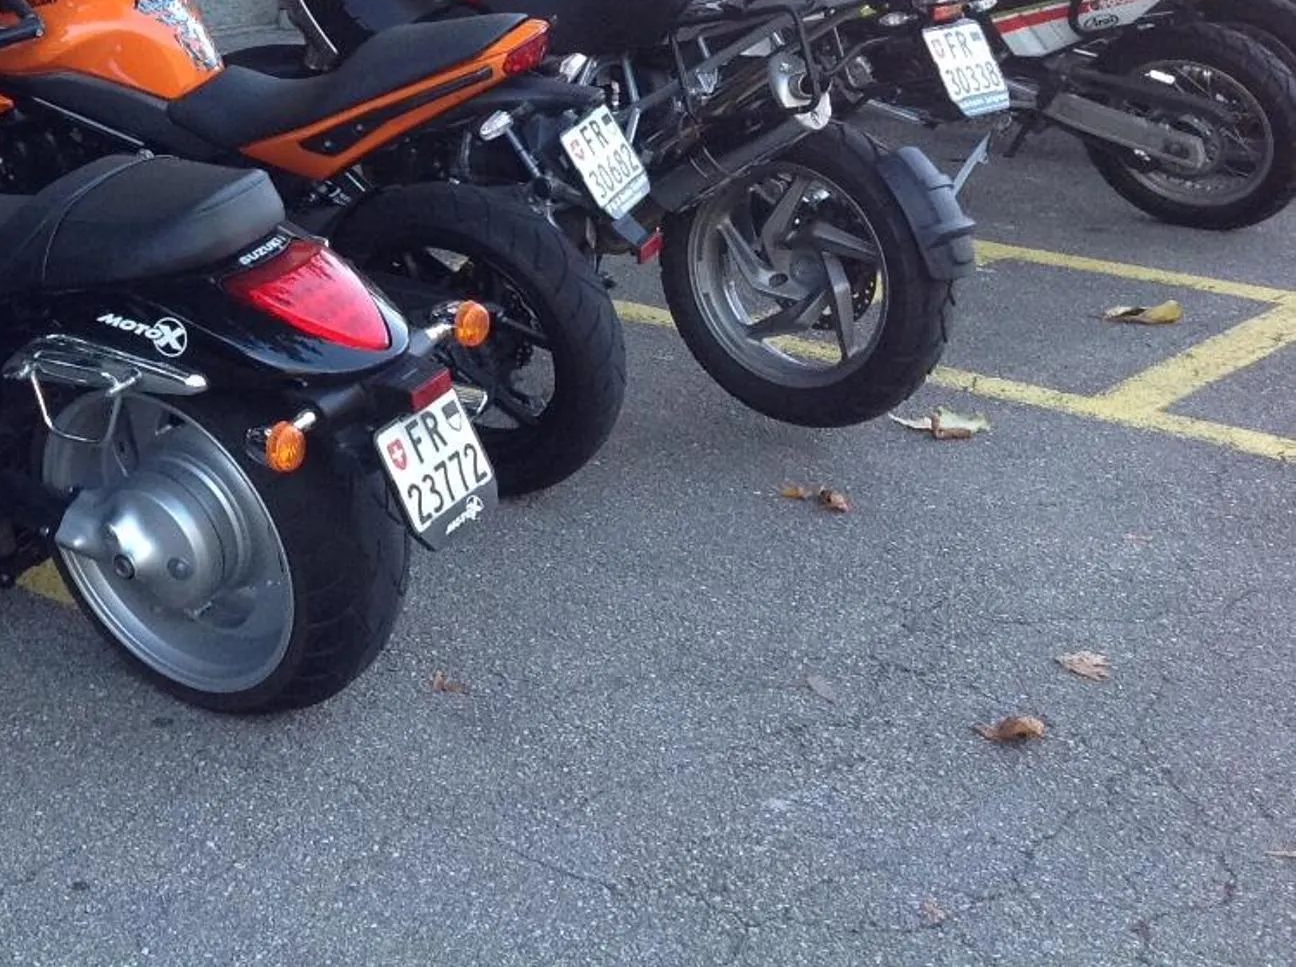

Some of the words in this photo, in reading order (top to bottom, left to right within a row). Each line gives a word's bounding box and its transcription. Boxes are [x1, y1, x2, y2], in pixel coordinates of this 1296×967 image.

[944, 31, 972, 59] FR
[945, 61, 1001, 96] 30338
[579, 119, 609, 156] FR
[589, 143, 639, 199] 30682
[239, 234, 286, 265] SUZUKI
[405, 410, 448, 464] FR
[407, 443, 487, 525] 23772
